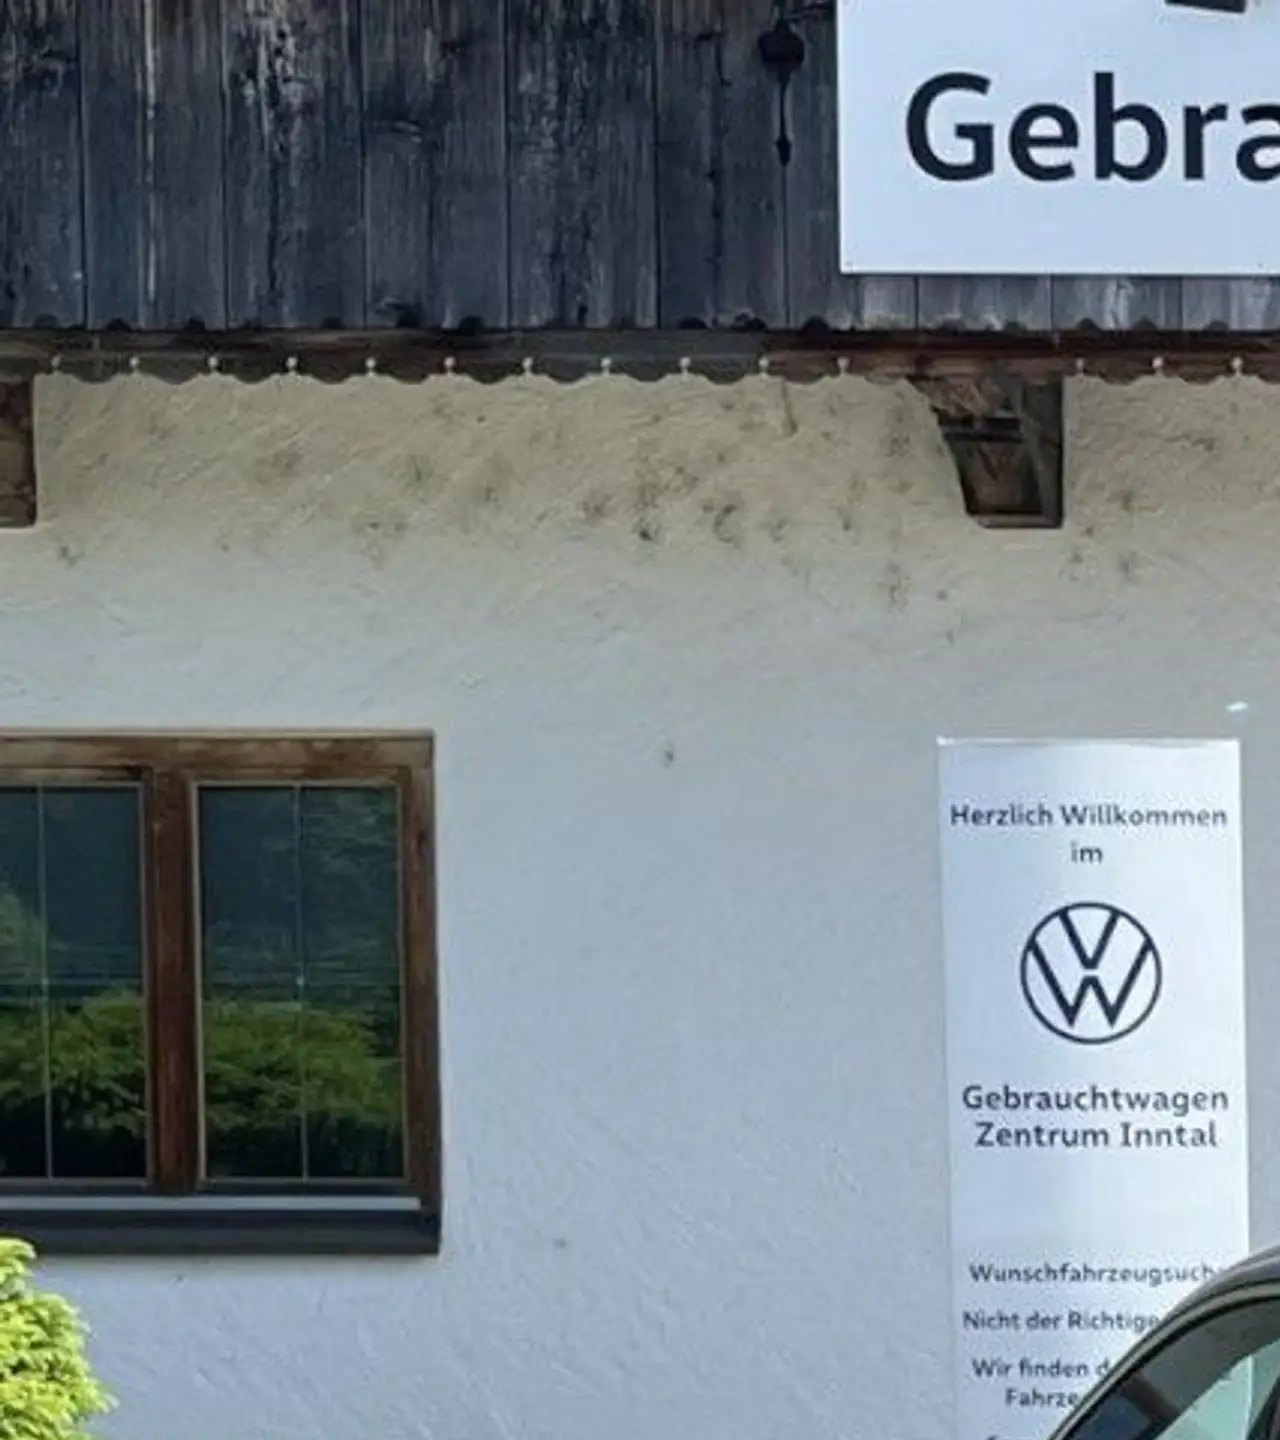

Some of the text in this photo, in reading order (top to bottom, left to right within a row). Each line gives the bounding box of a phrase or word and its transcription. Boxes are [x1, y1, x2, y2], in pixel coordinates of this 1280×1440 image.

[950, 803, 1228, 827] Herzlich Willkommen
[1070, 842, 1104, 863] im
[1020, 902, 1162, 1045] VW
[962, 1085, 1229, 1117] Gebrauchtwagen
[975, 1121, 1217, 1148] Zentrum Inntal
[968, 1263, 1215, 1286] Wunschfahrzeugsuch
[963, 1311, 1020, 1330] Nicht
[1026, 1311, 1060, 1330] der
[972, 1358, 1011, 1378] Wir
[1019, 1358, 1089, 1378] finden
[1005, 1387, 1076, 1406] Fahrze
